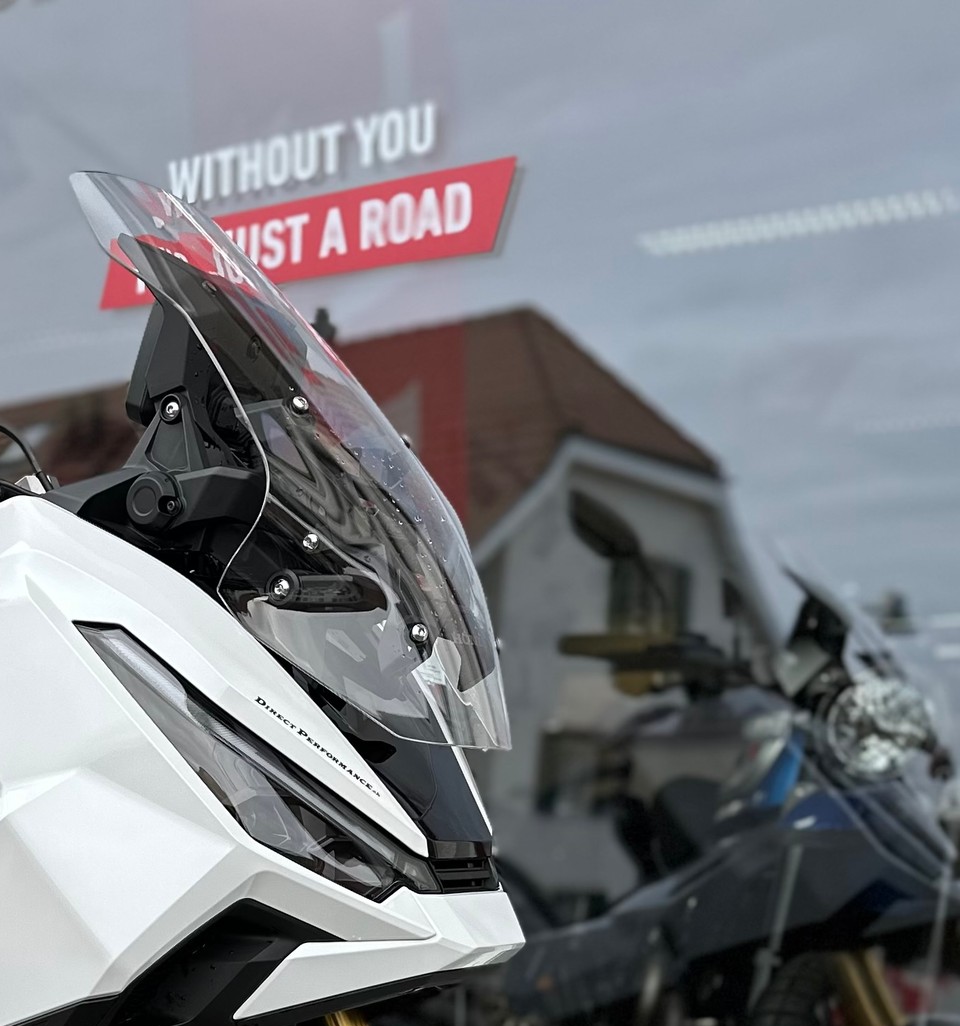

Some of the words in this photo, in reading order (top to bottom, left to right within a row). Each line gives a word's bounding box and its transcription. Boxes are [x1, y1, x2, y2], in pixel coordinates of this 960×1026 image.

[168, 122, 346, 204] WITHOUT
[354, 102, 436, 169] YOU
[318, 206, 348, 259] A
[360, 181, 473, 251] ROAD
[255, 695, 297, 730] DIRECT
